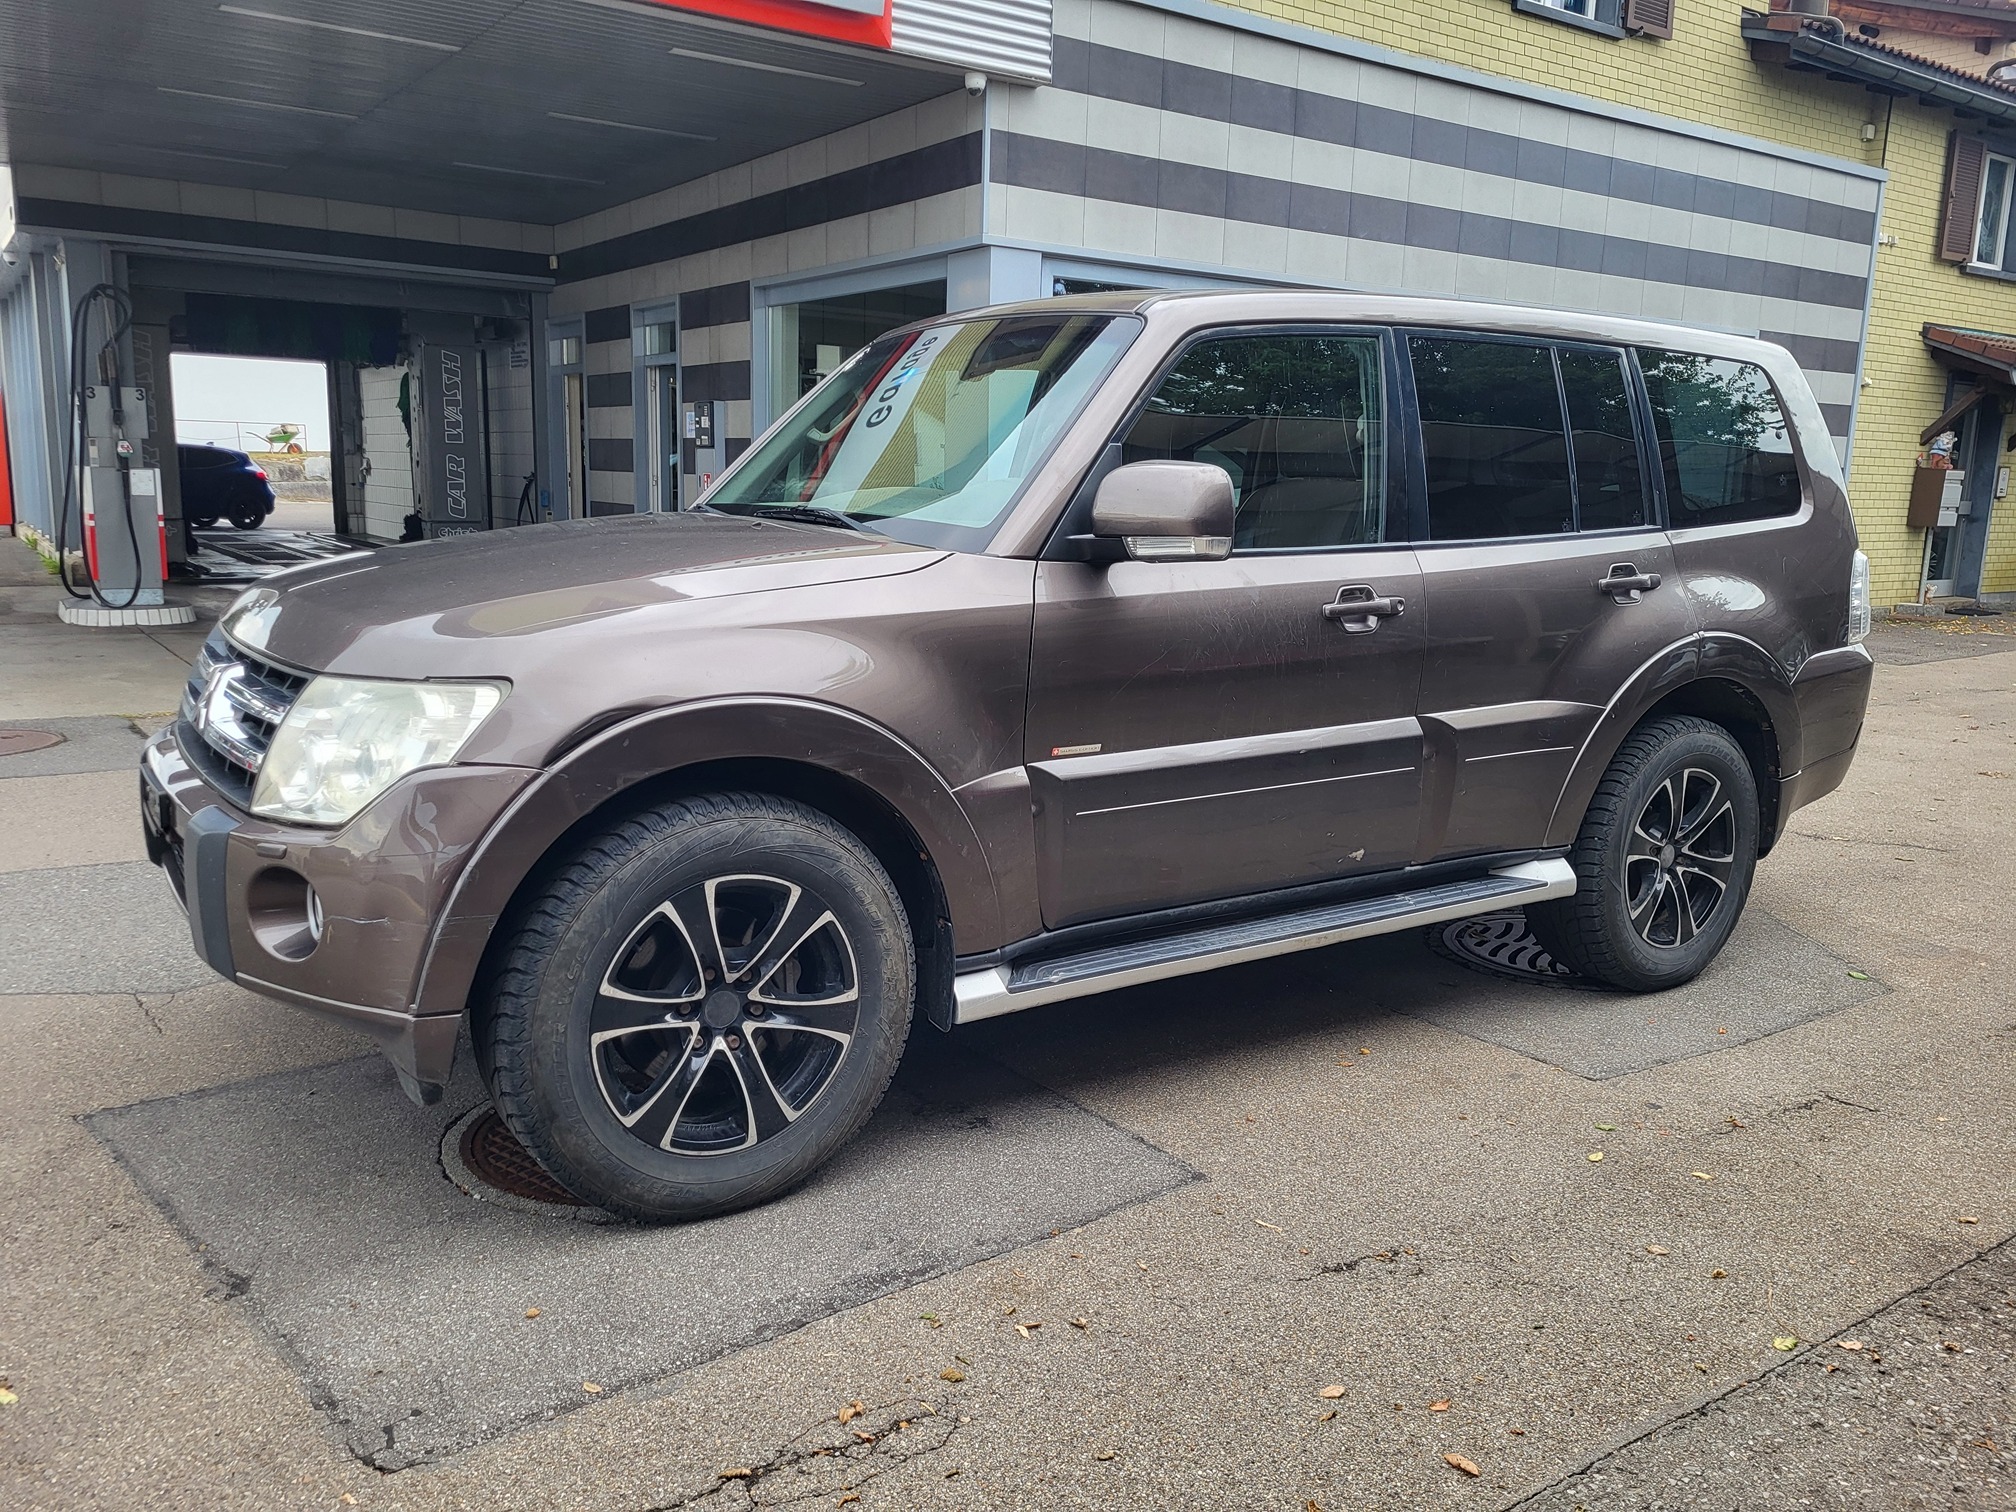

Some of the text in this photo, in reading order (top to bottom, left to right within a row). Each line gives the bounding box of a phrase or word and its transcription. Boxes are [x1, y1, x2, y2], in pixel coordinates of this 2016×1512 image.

[86, 386, 96, 399] 3
[135, 389, 145, 401] 3
[441, 349, 467, 519] CAR WASH
[836, 870, 899, 1001] COOPER
